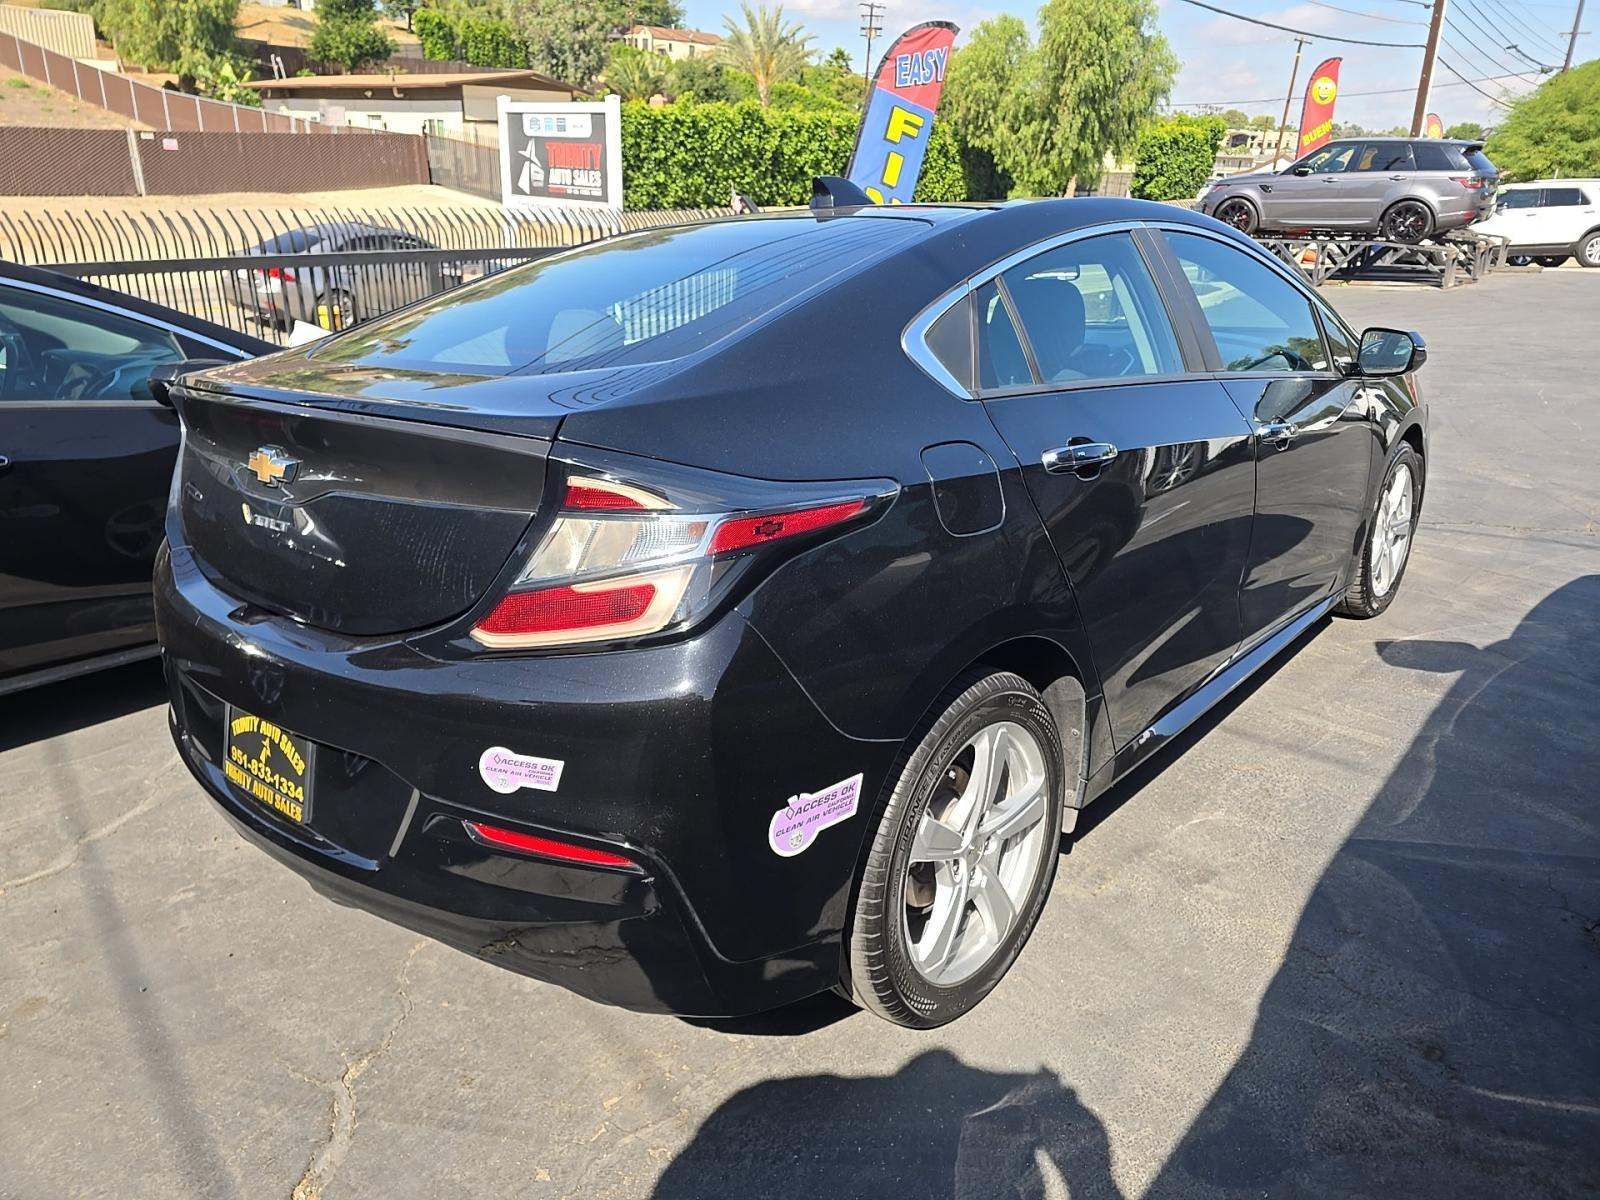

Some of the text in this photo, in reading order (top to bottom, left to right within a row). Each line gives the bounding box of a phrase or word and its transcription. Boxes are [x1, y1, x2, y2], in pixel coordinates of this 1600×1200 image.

[895, 46, 949, 88] EASY
[549, 168, 602, 187] AUTO SALES
[230, 715, 305, 776] TRINITY AUTO SALES
[485, 766, 508, 774] CLEAN
[500, 758, 556, 772] ACCESS OK
[225, 759, 303, 822] TRINITY AUTO SALES
[794, 791, 838, 817] ACCESS
[841, 781, 856, 796] OK
[775, 821, 804, 837] CLEAN
[805, 813, 820, 824] AIR
[822, 799, 854, 816] VEHICLE
